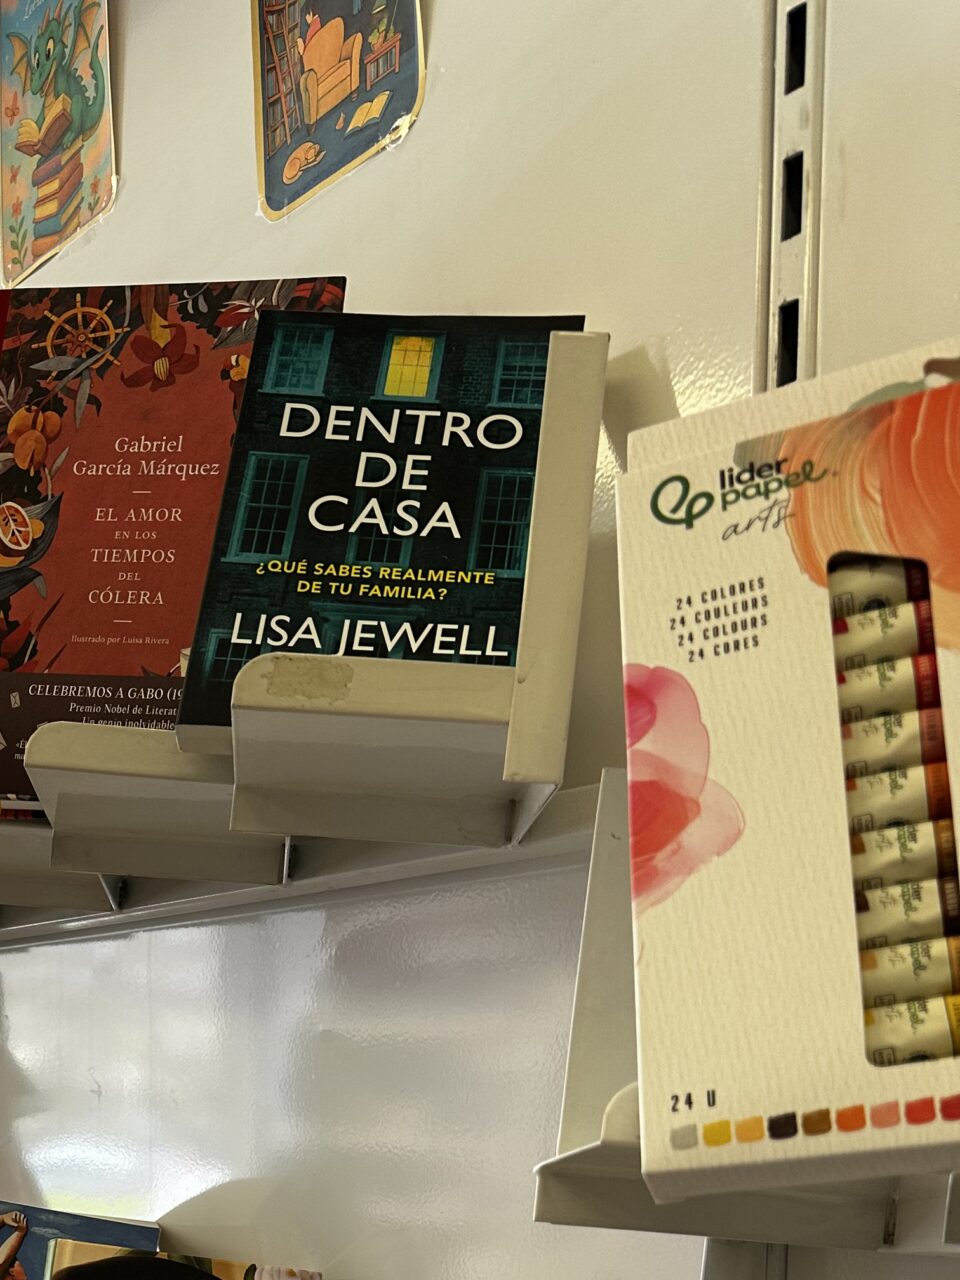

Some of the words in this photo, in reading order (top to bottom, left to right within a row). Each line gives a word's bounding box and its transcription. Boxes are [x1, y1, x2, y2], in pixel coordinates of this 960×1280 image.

[279, 402, 524, 450] DENTRO
[114, 435, 184, 453] Gabriel
[72, 459, 132, 476] García
[137, 459, 220, 481] Márquez
[355, 451, 432, 491] DE
[719, 457, 788, 491] lider
[721, 460, 828, 512] papel
[94, 508, 118, 522] EL
[125, 508, 183, 522] AMOR
[308, 495, 461, 539] CASA
[721, 498, 796, 541] arts
[114, 531, 130, 540] EN
[135, 531, 158, 540] LOS
[90, 548, 176, 563] TIEMPOS
[117, 572, 142, 581] DEL
[256, 559, 308, 575] ¿QUÉ
[313, 562, 372, 579] SABES
[379, 567, 496, 585] REALMENTE
[88, 585, 165, 605] CÓLERA
[297, 580, 323, 594] DE
[328, 582, 352, 595] TU
[359, 583, 448, 600] FAMILIA?
[676, 596, 692, 611] 24
[700, 577, 766, 604] COLORES
[670, 615, 686, 631] 24
[695, 595, 769, 625] COULEURS
[144, 636, 170, 646] Rivera
[230, 612, 322, 649] LISA
[337, 619, 509, 657] JEWELL
[678, 633, 694, 648] 24
[703, 613, 768, 640] COLOURS
[688, 648, 704, 663] 24
[713, 635, 760, 657] CORES
[28, 684, 113, 698] CELEBREMOS
[114, 687, 124, 699] A
[127, 687, 164, 700] GABO
[69, 703, 101, 714] Premio
[104, 703, 130, 715] Nobel
[132, 704, 143, 714] de
[670, 1092, 694, 1113] 24
[706, 1089, 717, 1108] U
